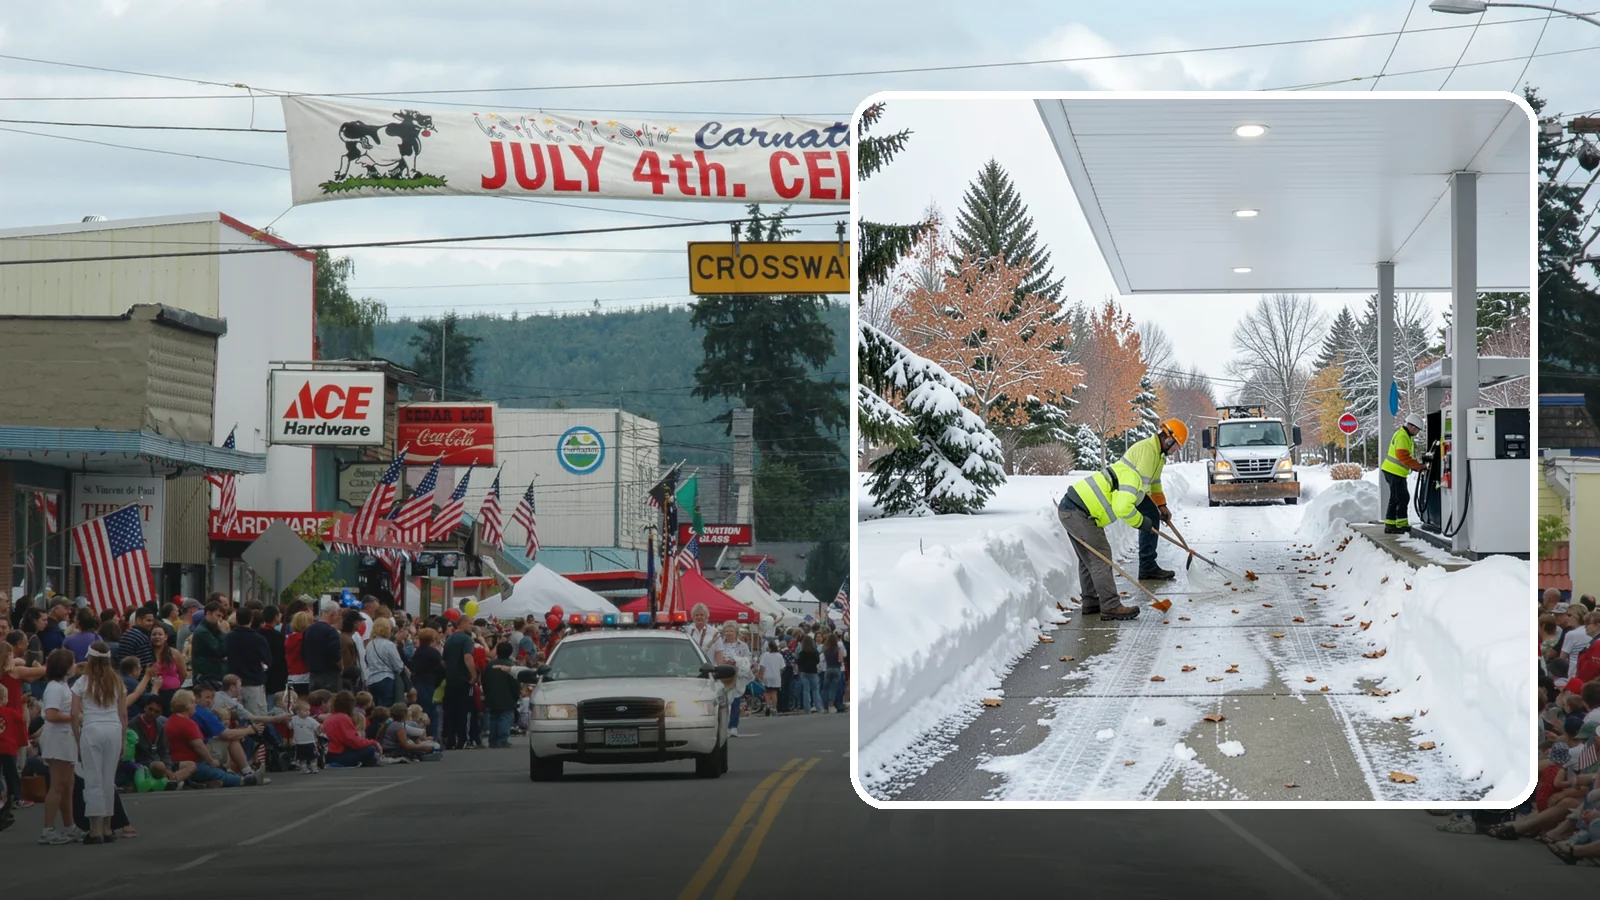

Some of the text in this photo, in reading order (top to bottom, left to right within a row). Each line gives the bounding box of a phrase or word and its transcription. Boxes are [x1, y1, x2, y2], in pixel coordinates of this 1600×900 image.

[481, 141, 604, 193] JULY
[632, 150, 746, 198] 4th.
[696, 254, 851, 281] CROSSWA
[283, 380, 373, 420] ACE
[405, 409, 452, 422] CEDAR
[283, 421, 370, 436] Hardware
[416, 428, 477, 447] Coca-Cola
[353, 467, 385, 479] Simpl
[96, 485, 123, 495] Vincent
[126, 486, 136, 495] de
[137, 486, 155, 495] Paul
[688, 526, 741, 535] CRNATION
[699, 535, 730, 543] GLASS
